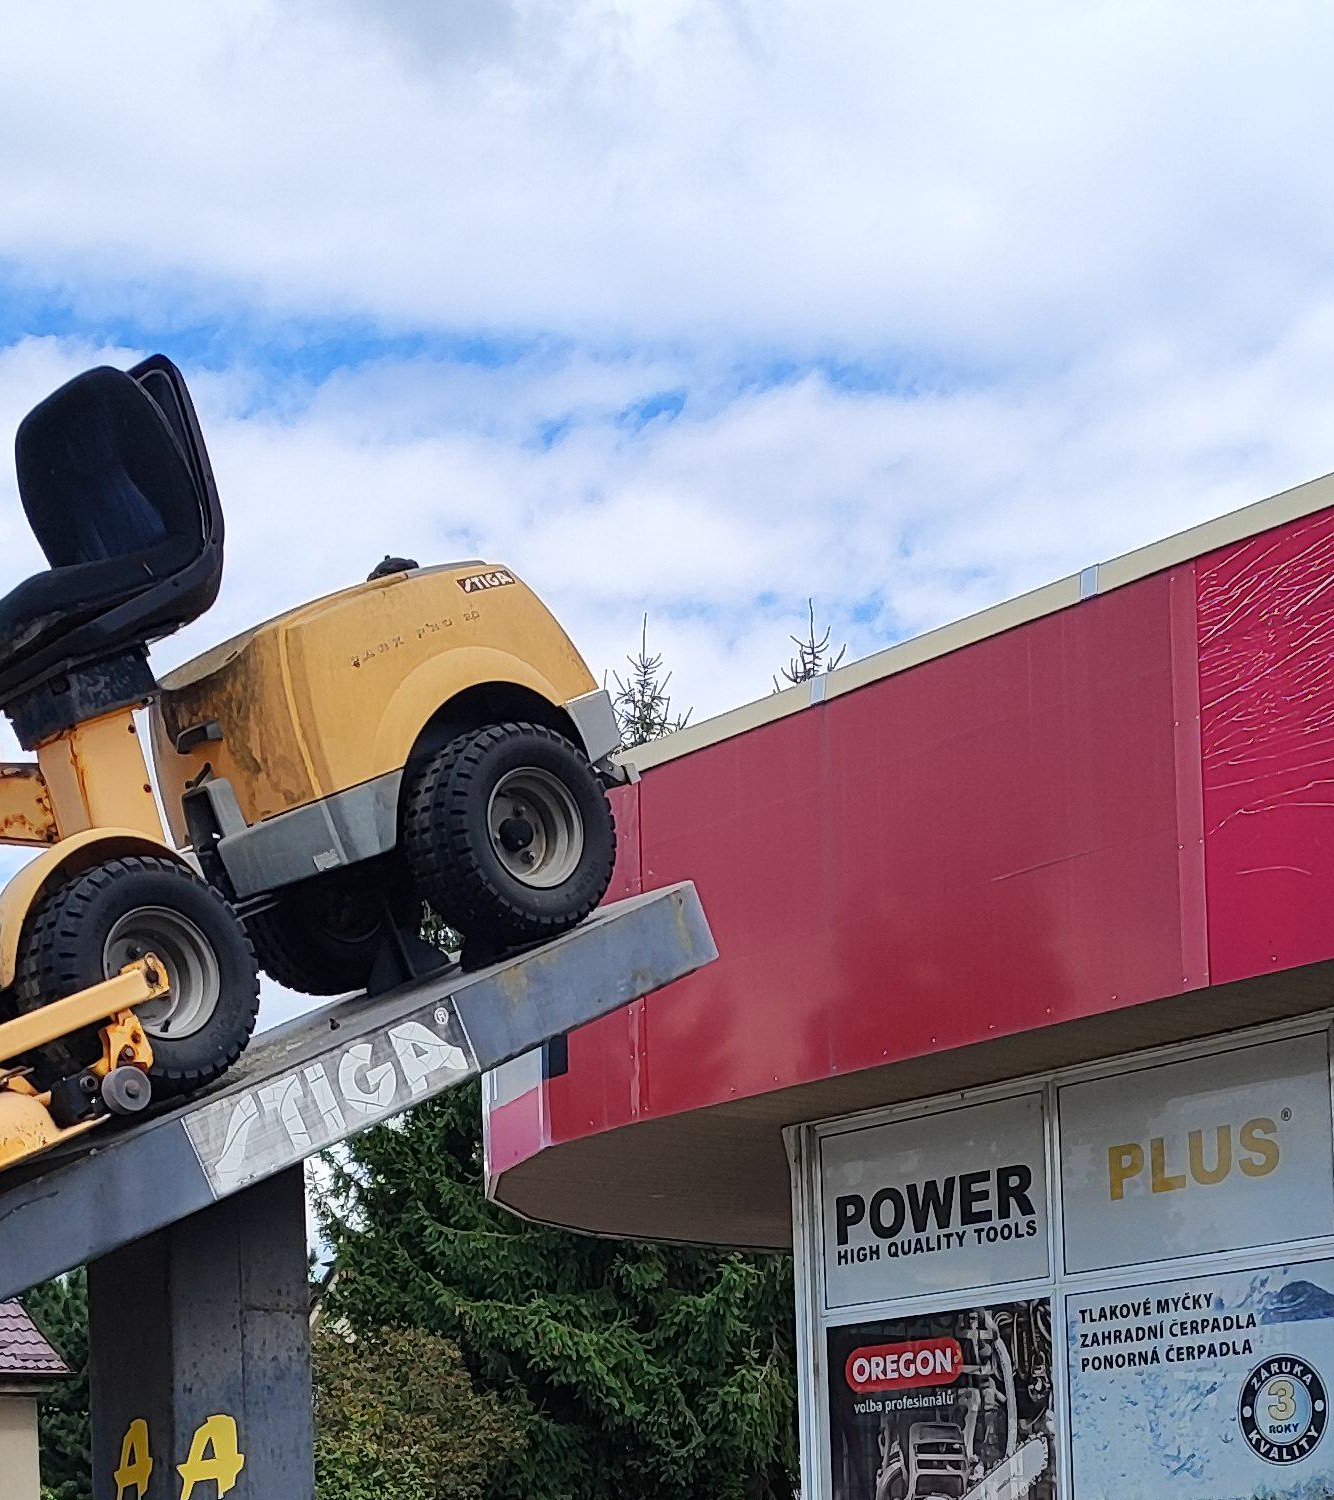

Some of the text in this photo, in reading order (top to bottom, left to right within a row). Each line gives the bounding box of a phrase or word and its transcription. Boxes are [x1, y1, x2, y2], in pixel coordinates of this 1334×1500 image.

[464, 570, 515, 592] STIGA
[214, 1020, 469, 1197] STIGA
[1108, 1117, 1281, 1201] PLUS
[835, 1163, 1037, 1247] POWER
[836, 1219, 1038, 1267] HIGH QUALITY TOOLS
[1078, 1292, 1214, 1324] TLAKOVÉ MYČKY
[1079, 1312, 1257, 1349] ZAHRADNÍ ČERPADLA
[851, 1346, 953, 1384] OREGON
[1080, 1338, 1254, 1373] PONORNÁ ČERPADLA
[853, 1389, 955, 1415] volba profesionálů
[1267, 1379, 1297, 1421] 3
[1247, 1424, 1319, 1460] KVALITY
[1268, 1422, 1300, 1435] ROKY
